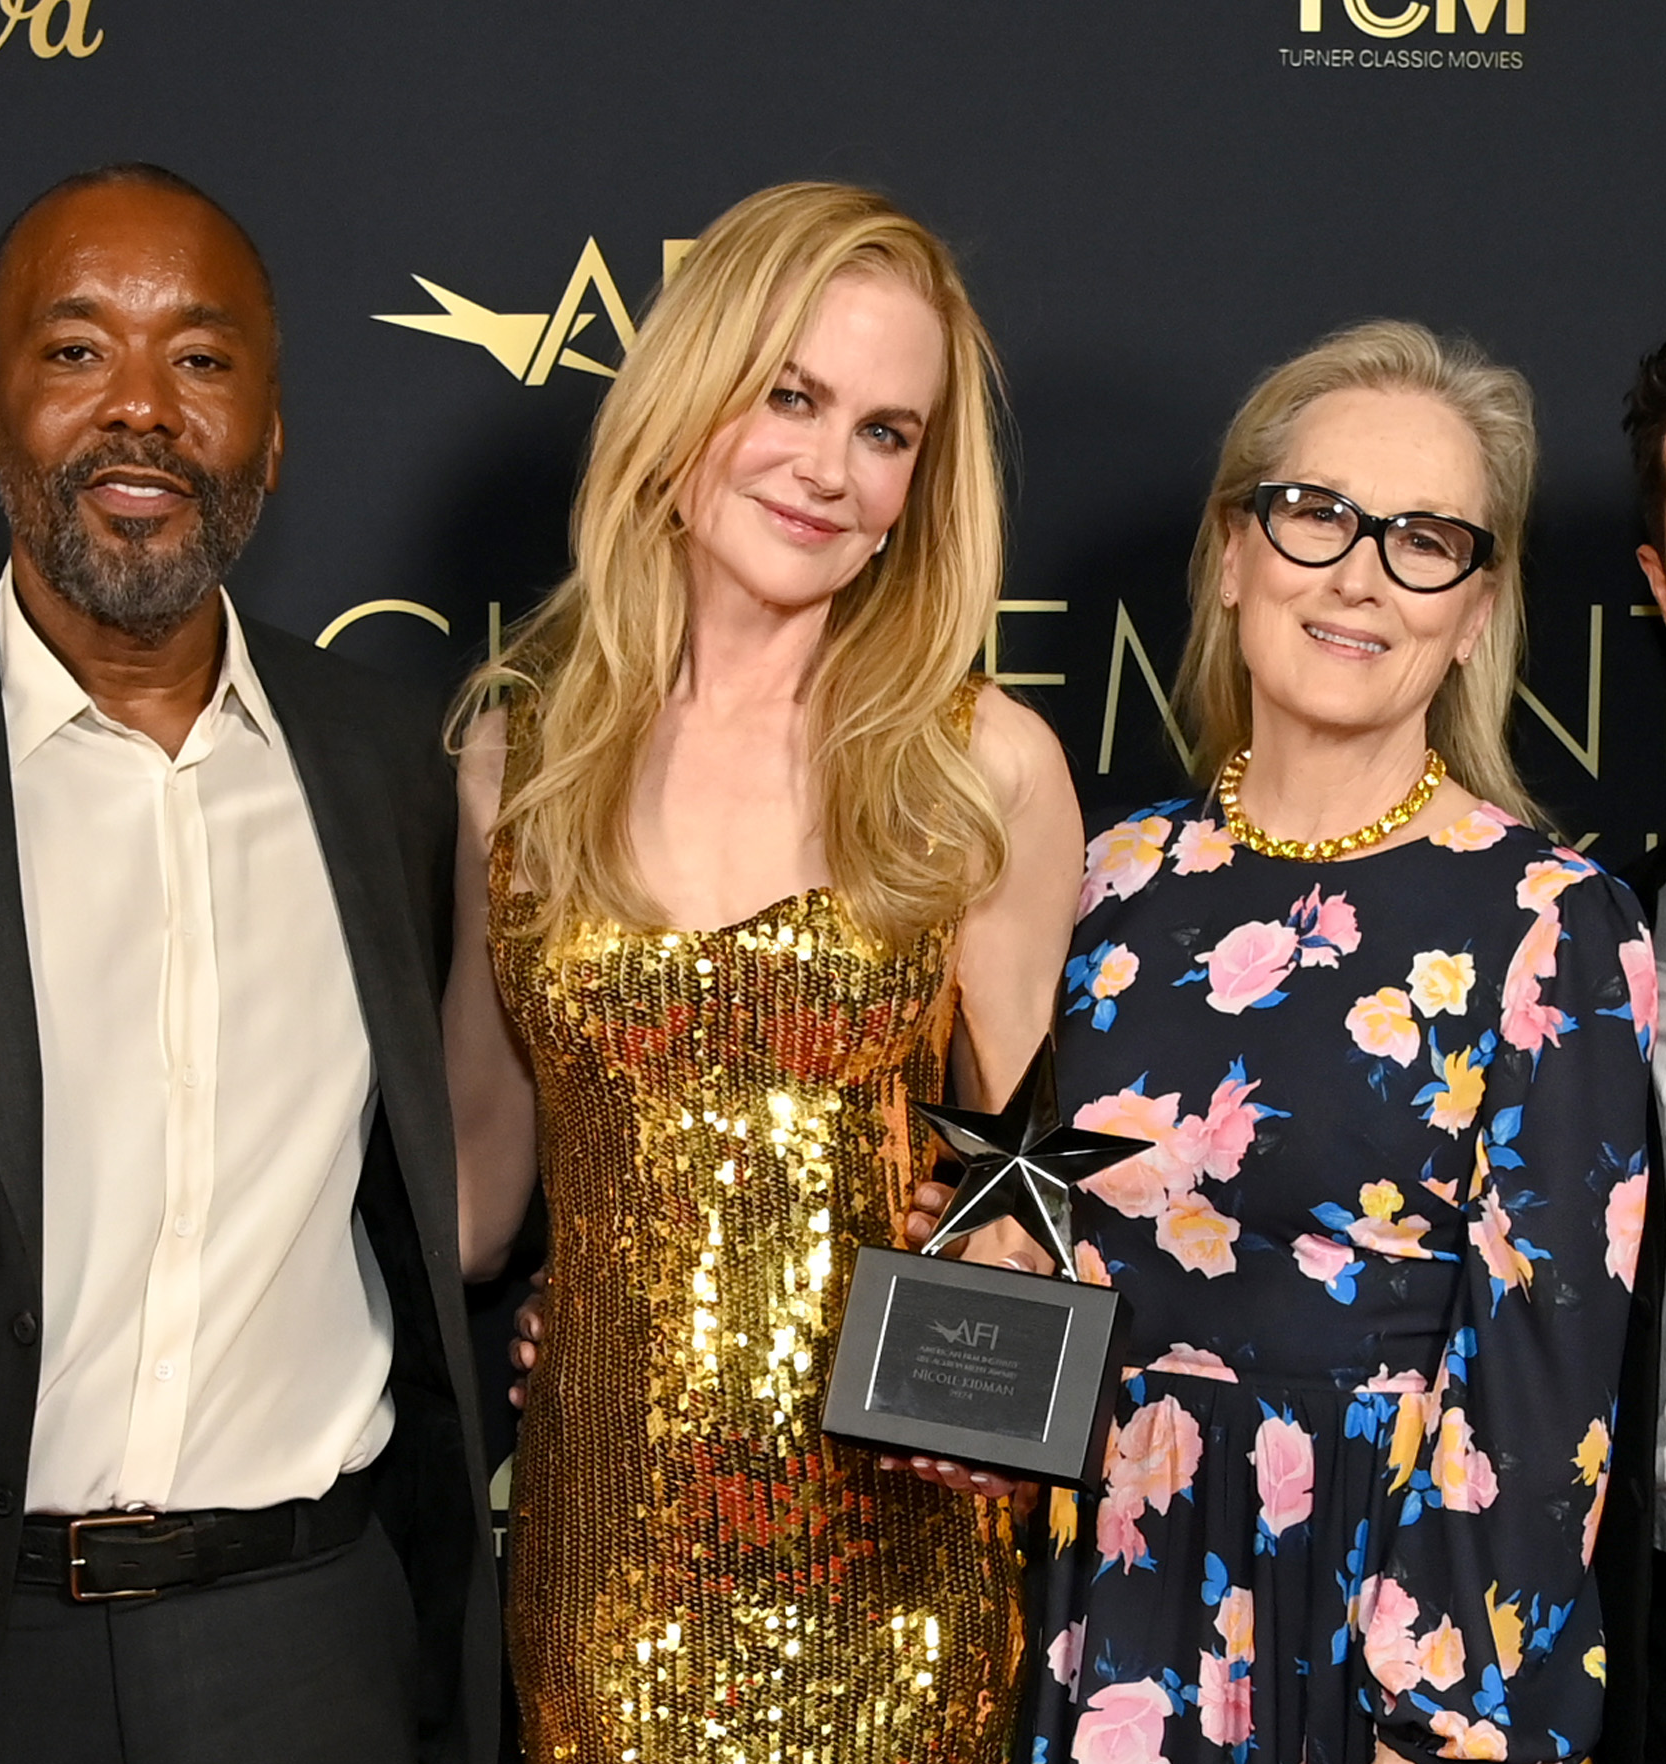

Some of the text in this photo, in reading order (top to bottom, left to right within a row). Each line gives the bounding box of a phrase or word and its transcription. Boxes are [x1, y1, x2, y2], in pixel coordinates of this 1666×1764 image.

[1278, 48, 1523, 70] TURNER CLASSIC MOVIES
[948, 1318, 1001, 1351] AFI
